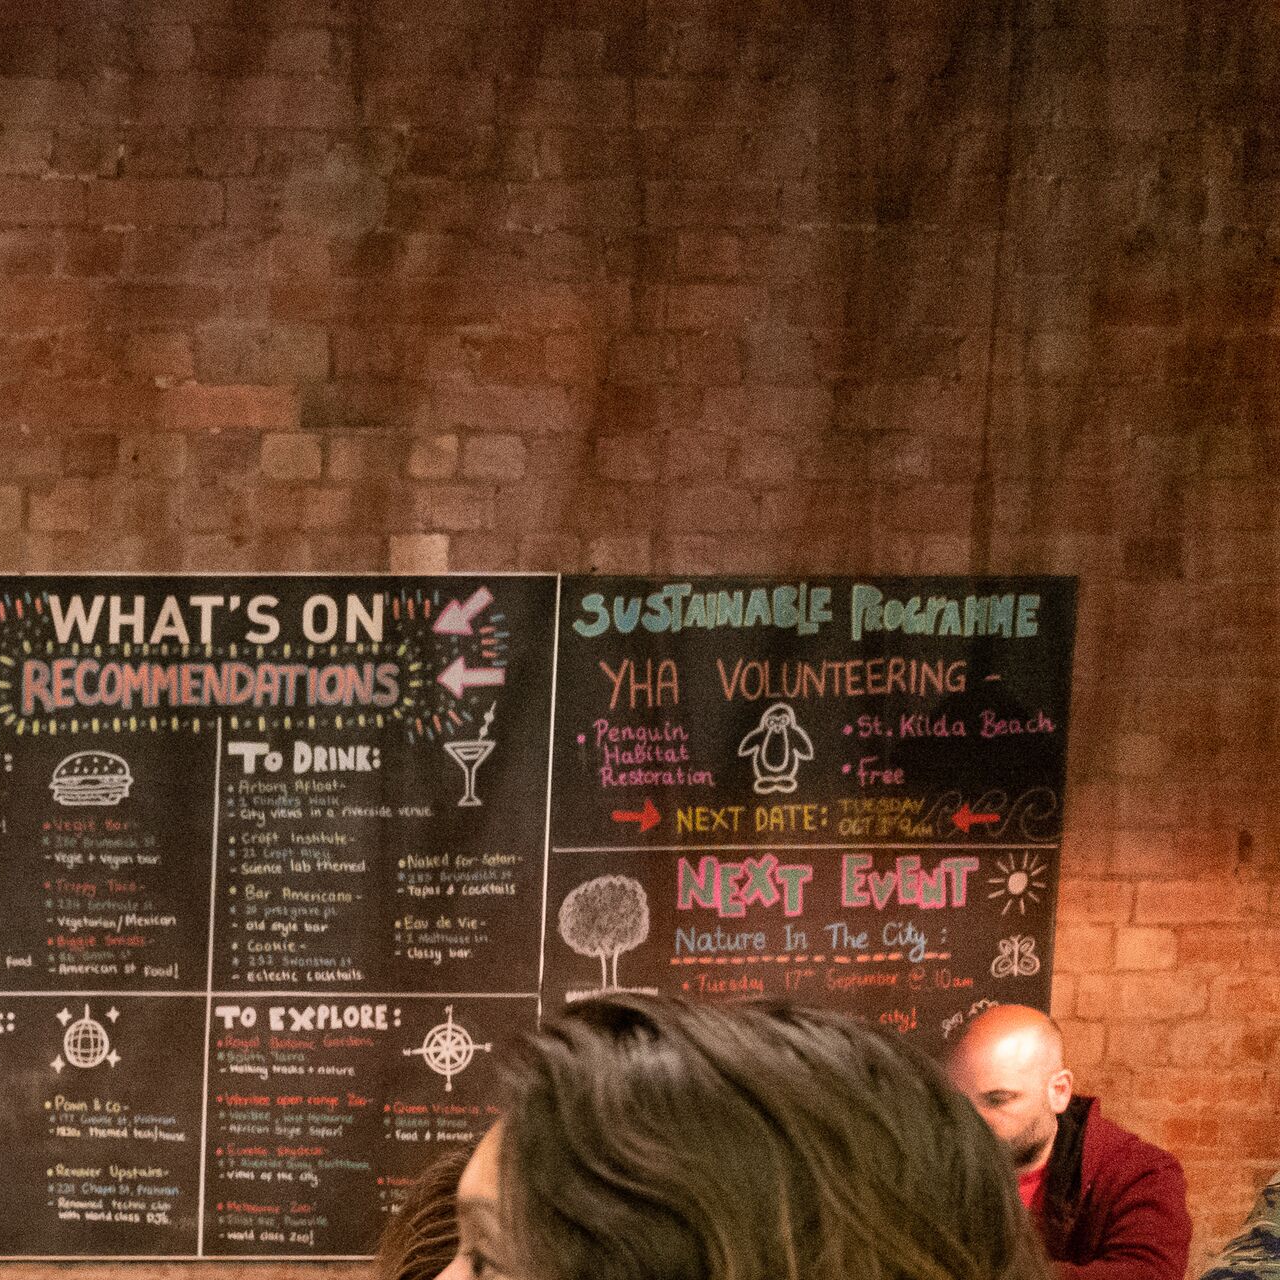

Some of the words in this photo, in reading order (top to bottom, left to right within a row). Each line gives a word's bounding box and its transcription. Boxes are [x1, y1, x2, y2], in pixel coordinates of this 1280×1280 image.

[47, 593, 282, 646] WHAT'S
[300, 594, 386, 645] ON
[22, 658, 402, 714] RECOMMENDATIONS
[600, 658, 680, 711] YHA
[717, 657, 968, 701] VOLUNTEERING
[593, 718, 689, 747] Penguin
[856, 714, 894, 738] St.
[899, 713, 967, 739] Kilda
[980, 711, 1055, 738] Beach
[600, 765, 716, 790] Restoration
[858, 759, 906, 786] Free
[676, 805, 745, 834] NEXT
[755, 803, 828, 833] DATE:
[676, 854, 814, 918] NEXT
[840, 854, 980, 911] EVENT
[674, 926, 767, 955] Nature
[784, 925, 808, 949] In
[824, 922, 869, 950] The
[698, 972, 765, 994] Tuesday
[215, 1005, 258, 1030] TO
[268, 1003, 402, 1032] EXPLORE:
